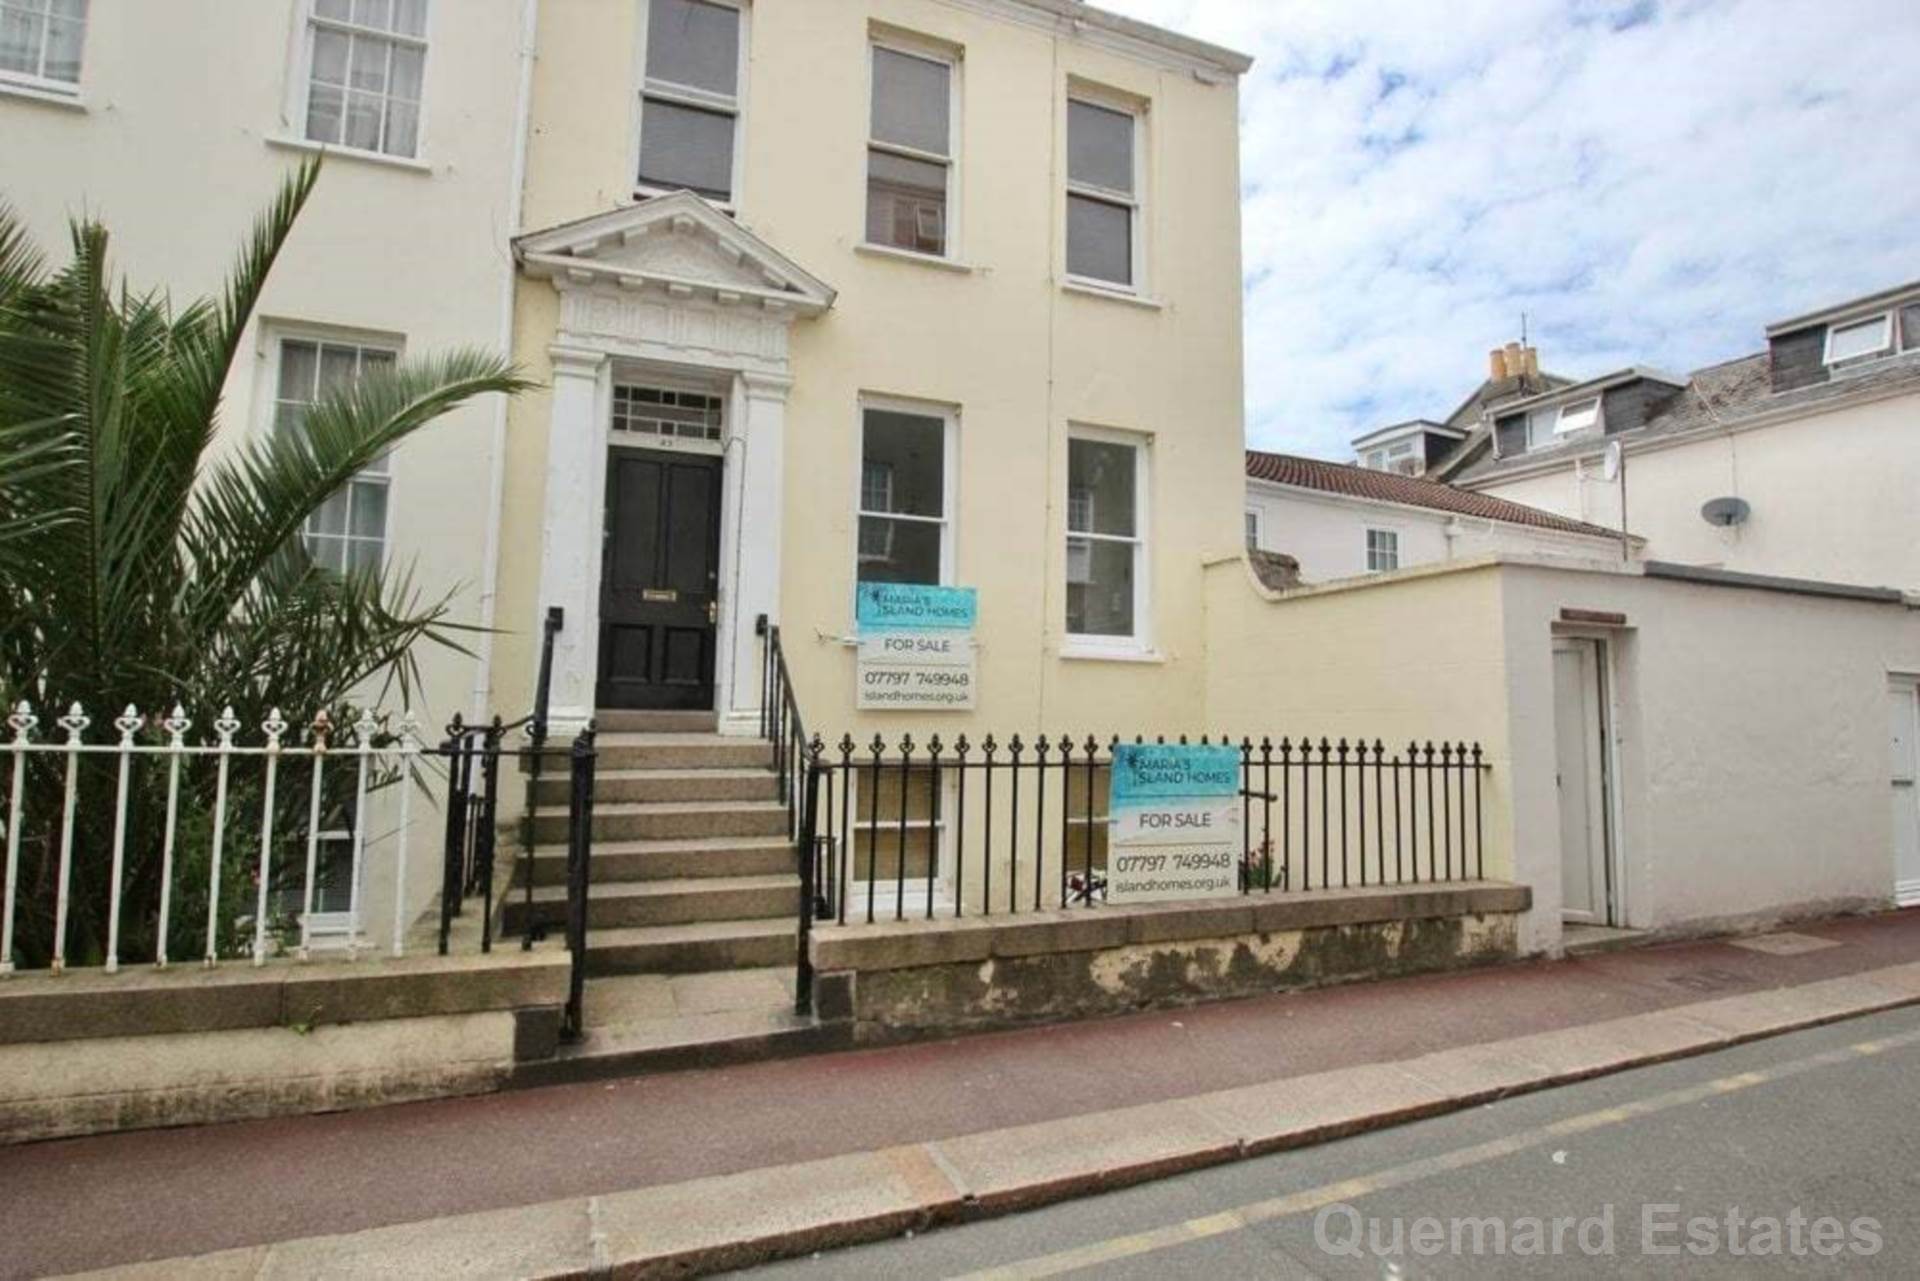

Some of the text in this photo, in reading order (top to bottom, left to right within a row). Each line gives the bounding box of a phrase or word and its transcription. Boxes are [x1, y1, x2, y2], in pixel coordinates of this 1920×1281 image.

[927, 607, 968, 618] HOMES
[884, 638, 951, 653] FOR SALE
[864, 671, 969, 686] 07797 749948
[864, 690, 969, 704] islandhomes.org.uk
[1187, 771, 1231, 784] HOMES
[1139, 812, 1212, 828] FOR SALE
[1116, 852, 1231, 873] 07797 749948
[1115, 876, 1231, 893] islandhomes.org.uk
